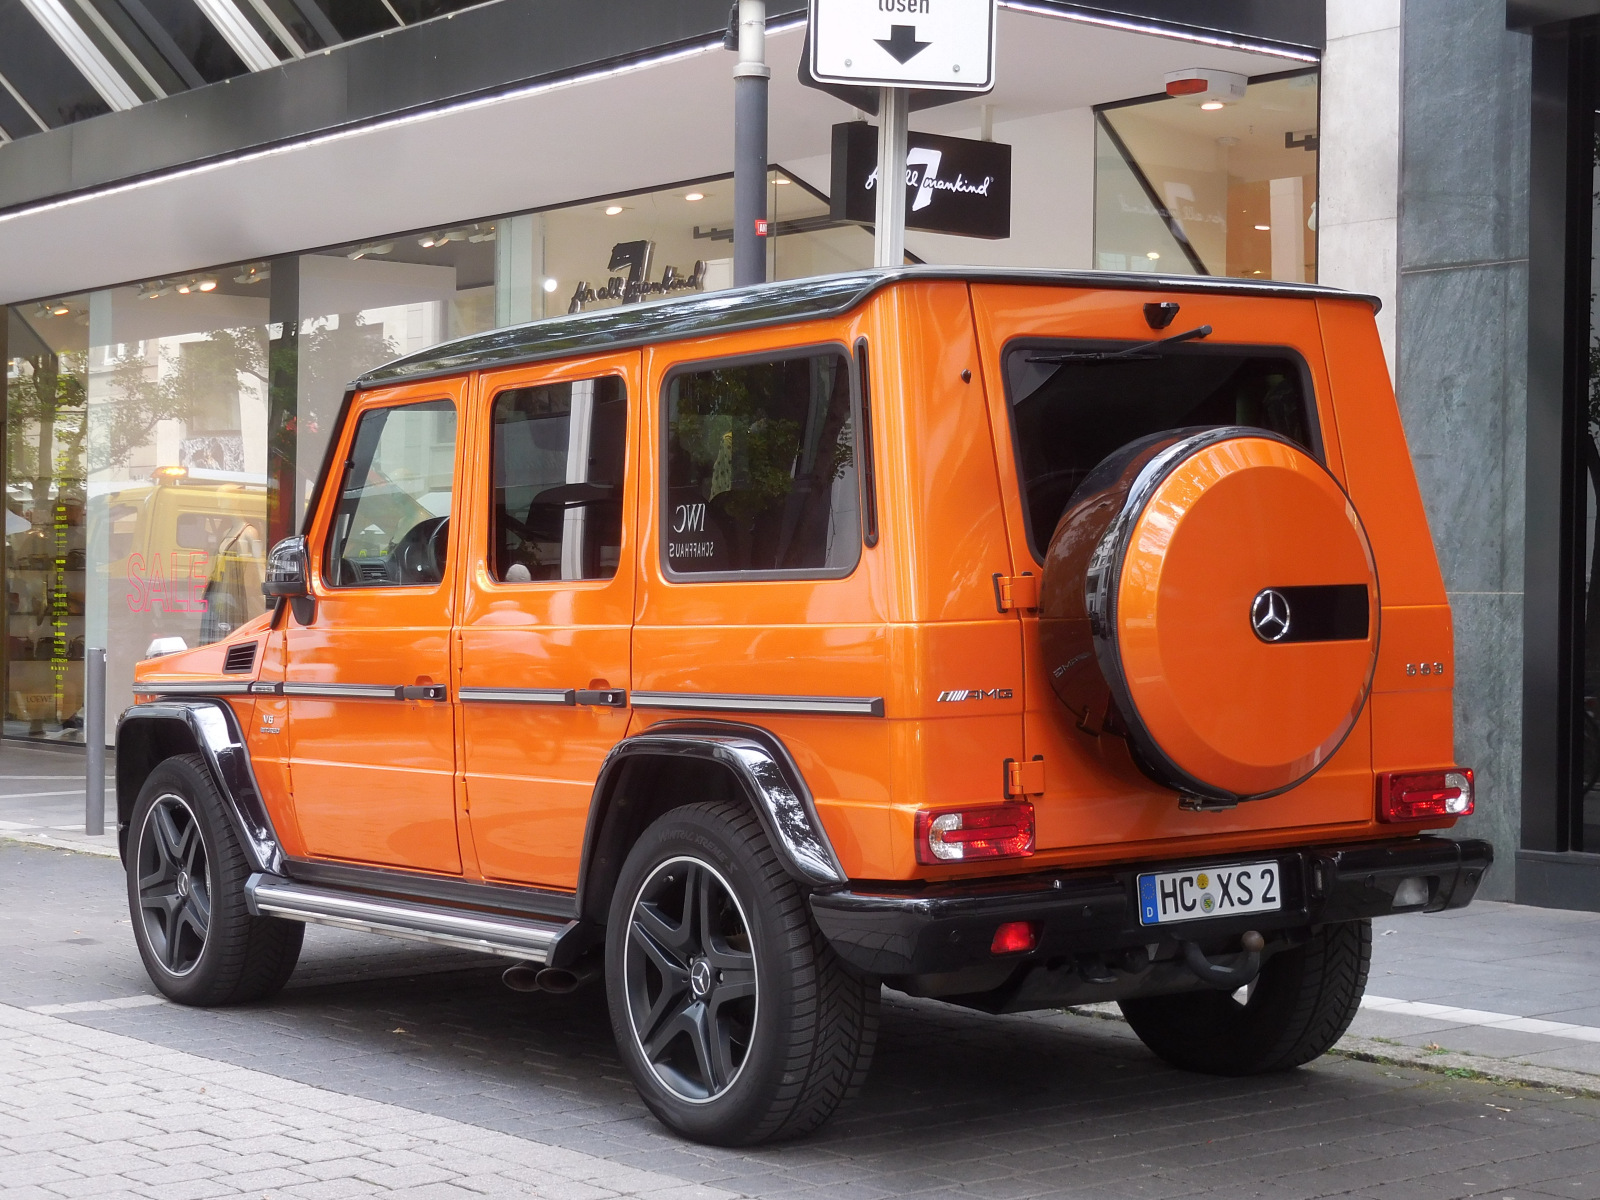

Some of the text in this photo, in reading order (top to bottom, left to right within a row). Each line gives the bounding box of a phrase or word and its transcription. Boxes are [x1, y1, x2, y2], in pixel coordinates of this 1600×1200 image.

[906, 147, 942, 212] 7
[923, 173, 990, 197] mankind
[607, 240, 651, 305] 7
[126, 551, 209, 613] SALE
[1146, 906, 1154, 918] D
[1160, 868, 1277, 915] HC XS 2
